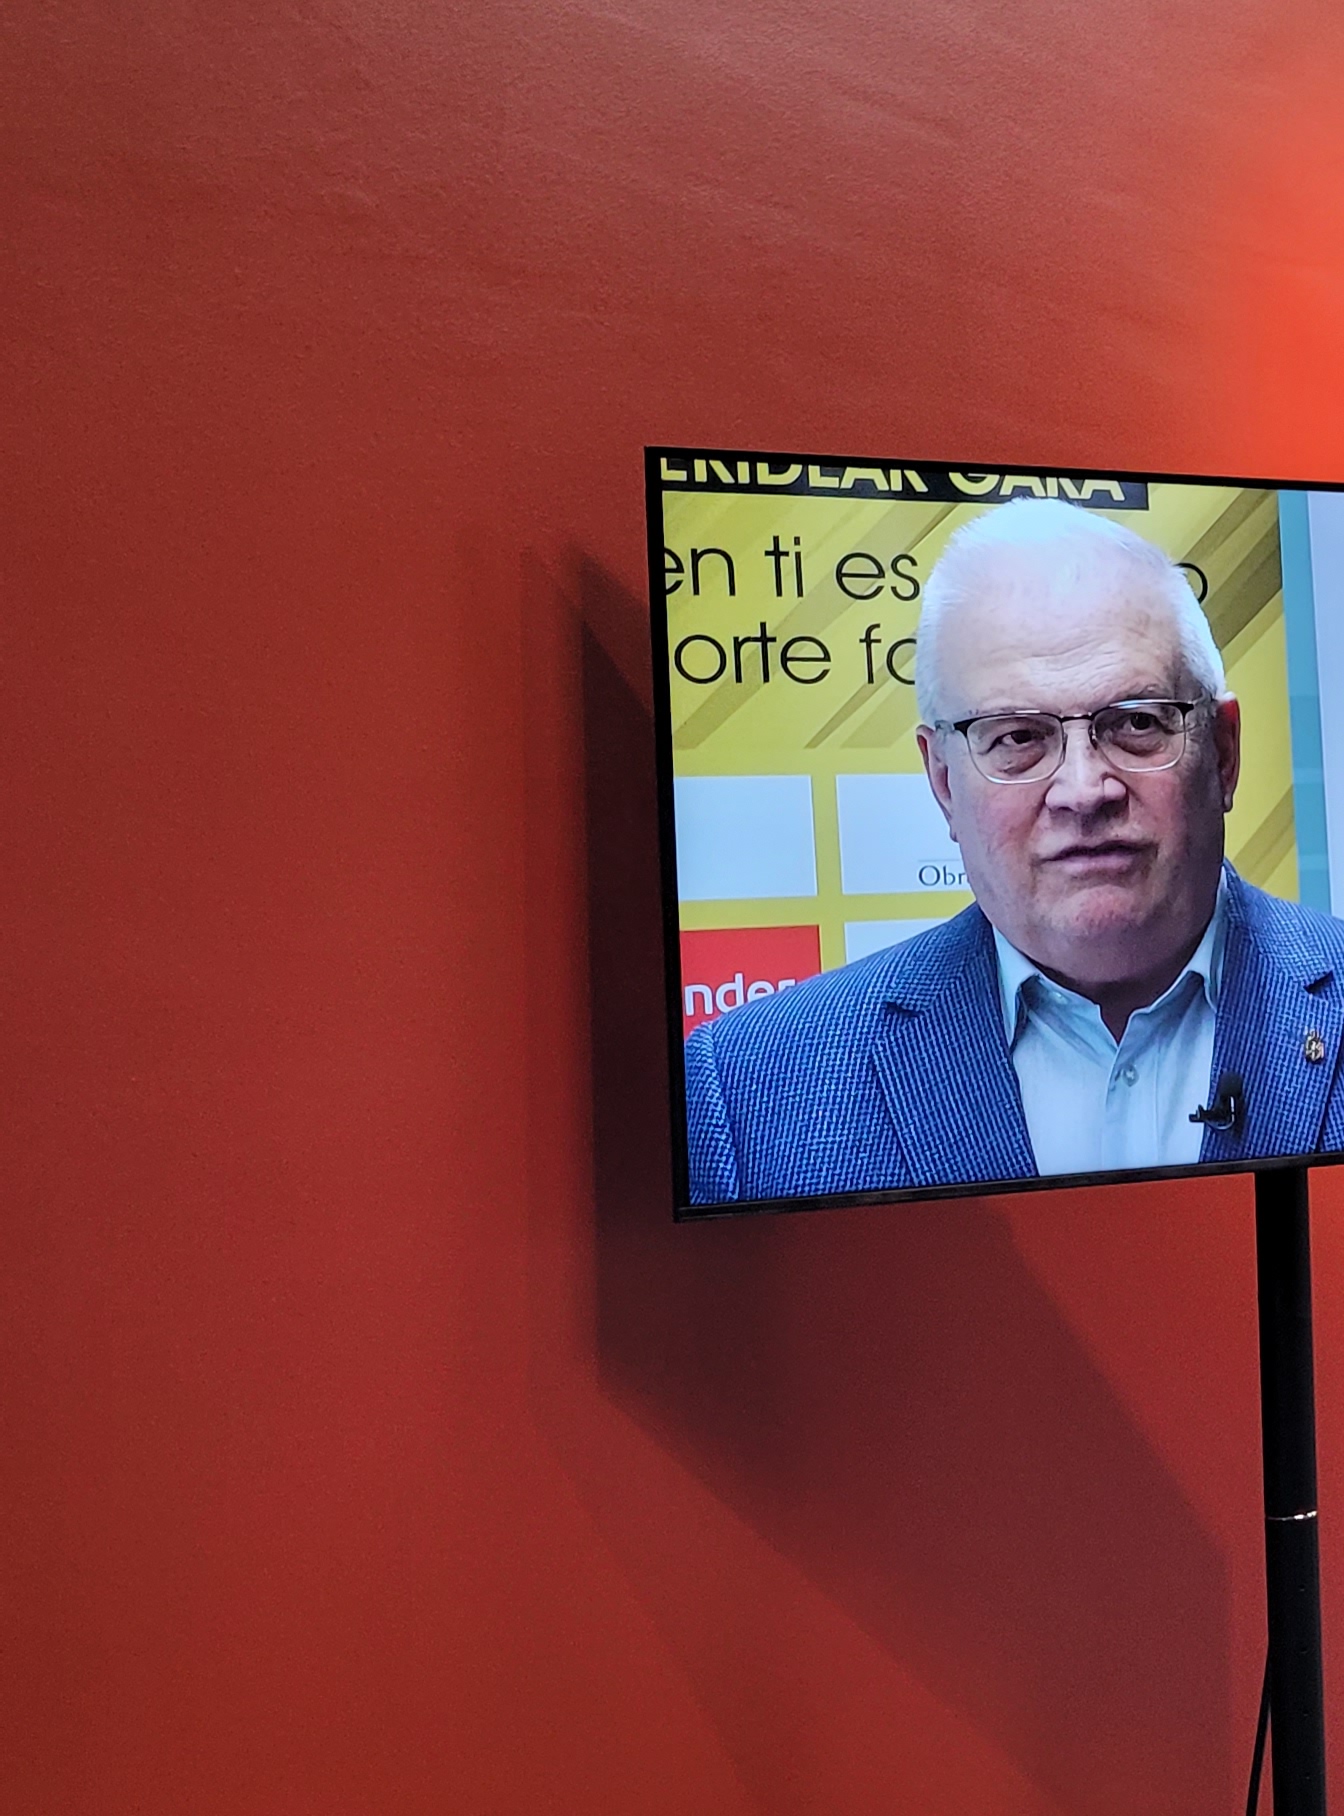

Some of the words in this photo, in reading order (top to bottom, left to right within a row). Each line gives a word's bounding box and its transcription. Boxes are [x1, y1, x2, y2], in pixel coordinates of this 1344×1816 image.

[764, 536, 804, 597] ti
[835, 552, 920, 601] es
[674, 621, 832, 685] orte
[684, 972, 796, 1017] nde
